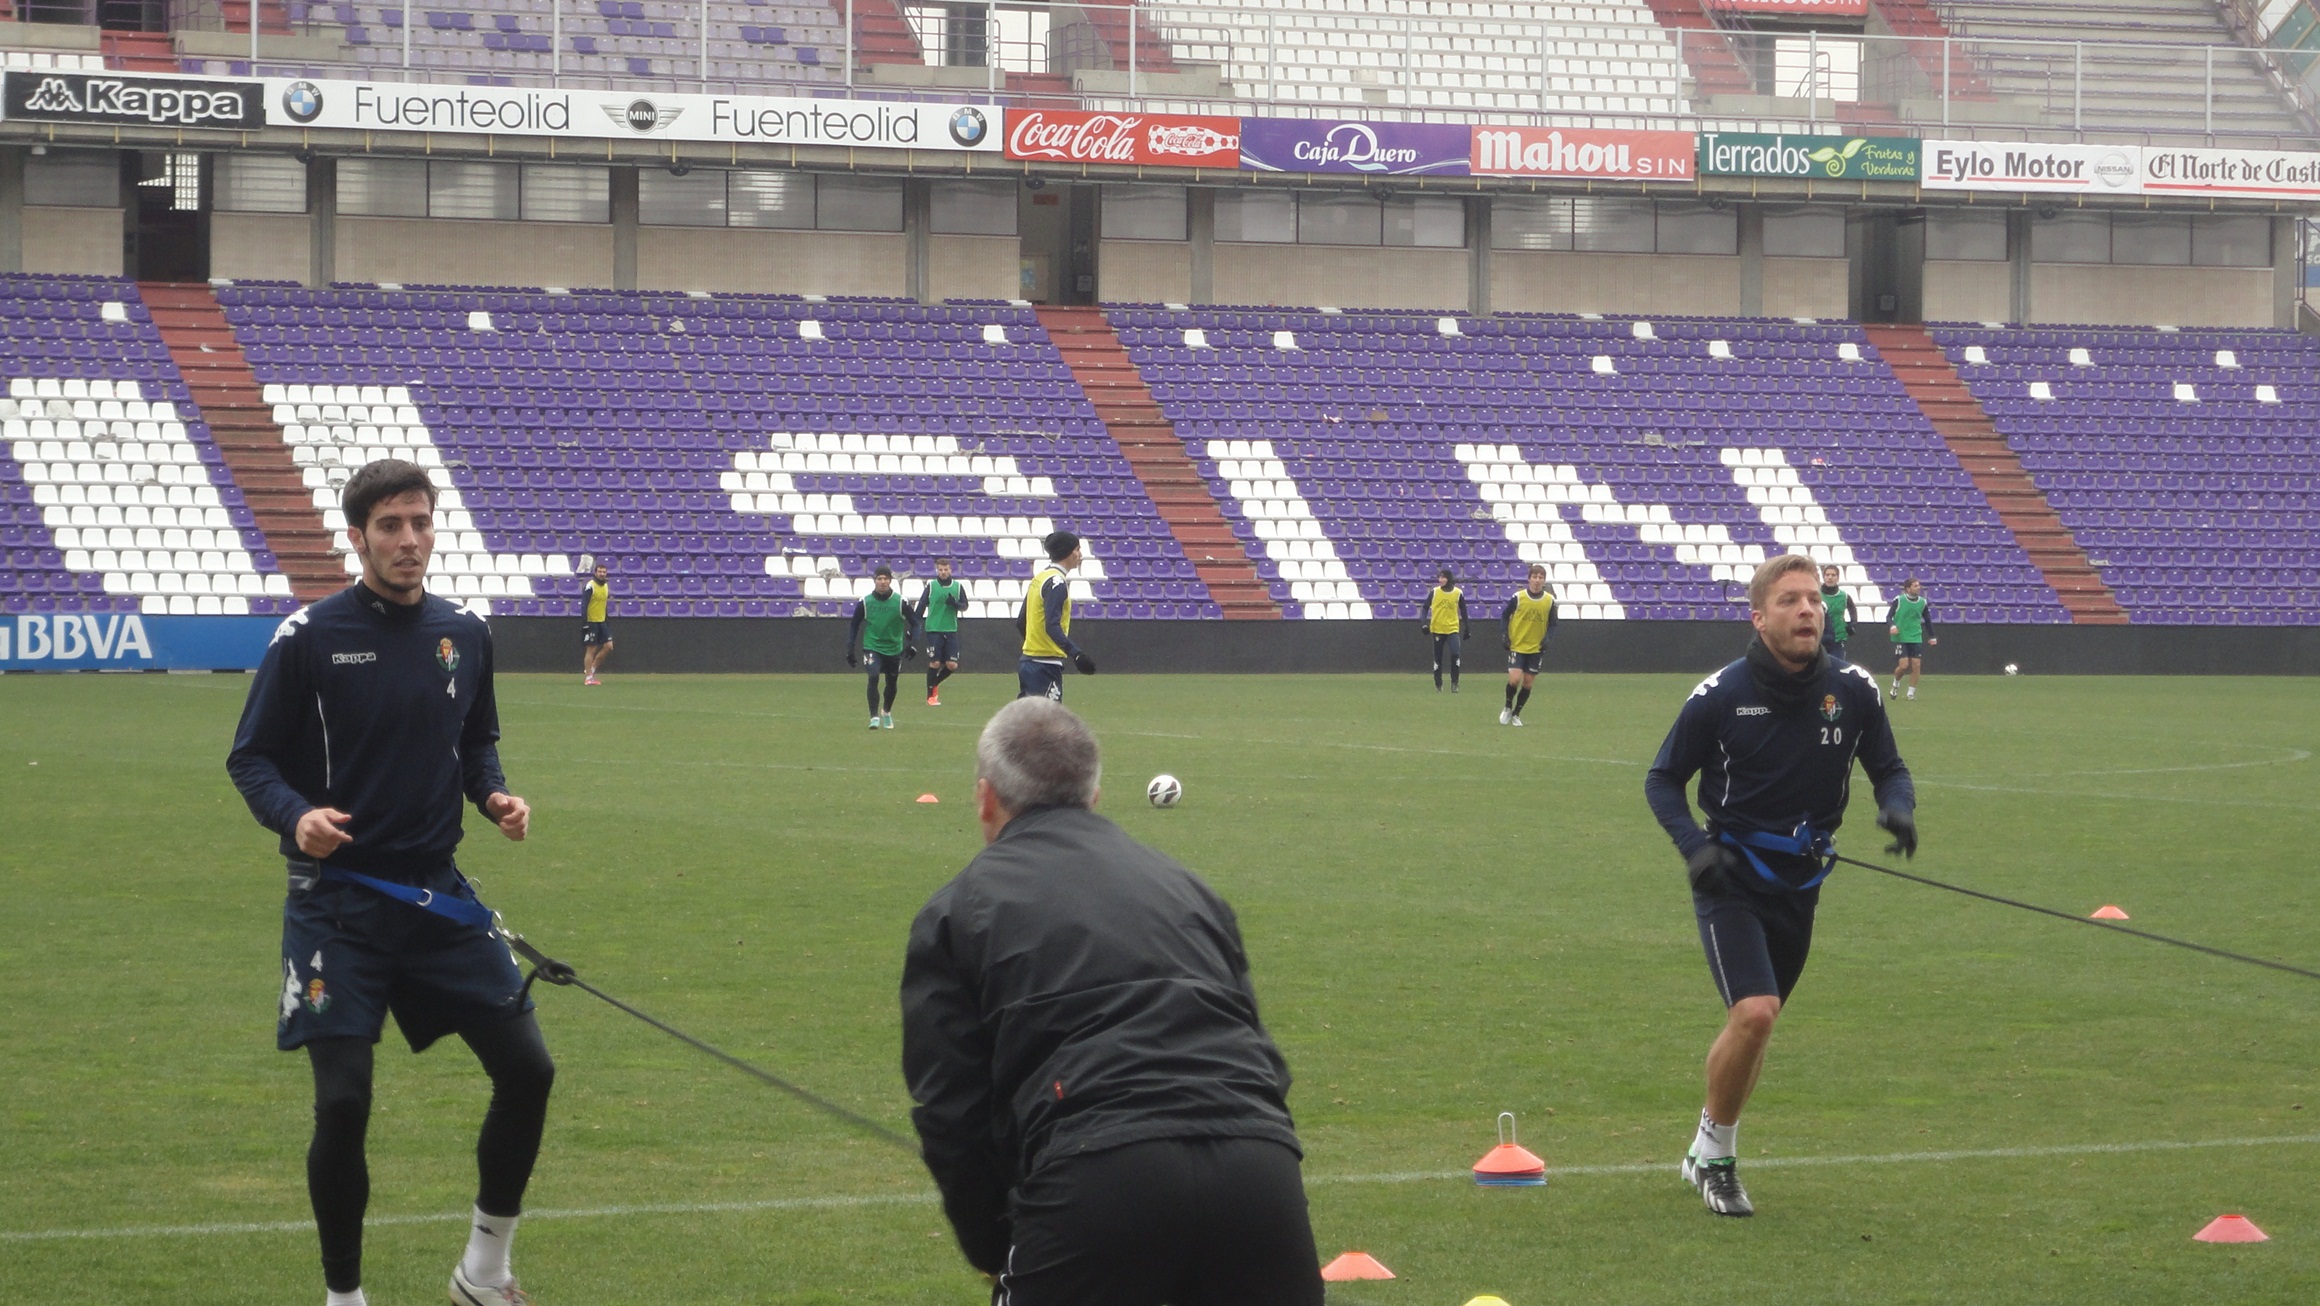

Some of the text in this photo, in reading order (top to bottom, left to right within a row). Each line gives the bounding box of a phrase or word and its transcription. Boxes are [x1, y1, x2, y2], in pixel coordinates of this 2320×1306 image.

[86, 80, 243, 123] Kappa
[355, 86, 570, 130] Fuenteolid
[629, 110, 655, 121] MINI
[712, 99, 919, 143] Fuenteolid
[1010, 112, 1143, 160] Coca-Cola
[1293, 123, 1417, 166] Caja Duero
[1476, 130, 1686, 175] Mahou SIN
[1704, 134, 1810, 175] Terrados
[1861, 144, 1915, 165] Frutas y
[1861, 161, 1915, 177] Verduras
[1937, 150, 2085, 182] Eylo Motor
[2097, 165, 2131, 174] NISSAN
[2149, 153, 2176, 179] El
[2180, 154, 2237, 181] Norte
[2241, 158, 2263, 182] de
[17, 615, 153, 660] BBVA
[331, 651, 377, 664] Kappa
[446, 677, 456, 699] 4
[1736, 706, 1772, 716] Kapp
